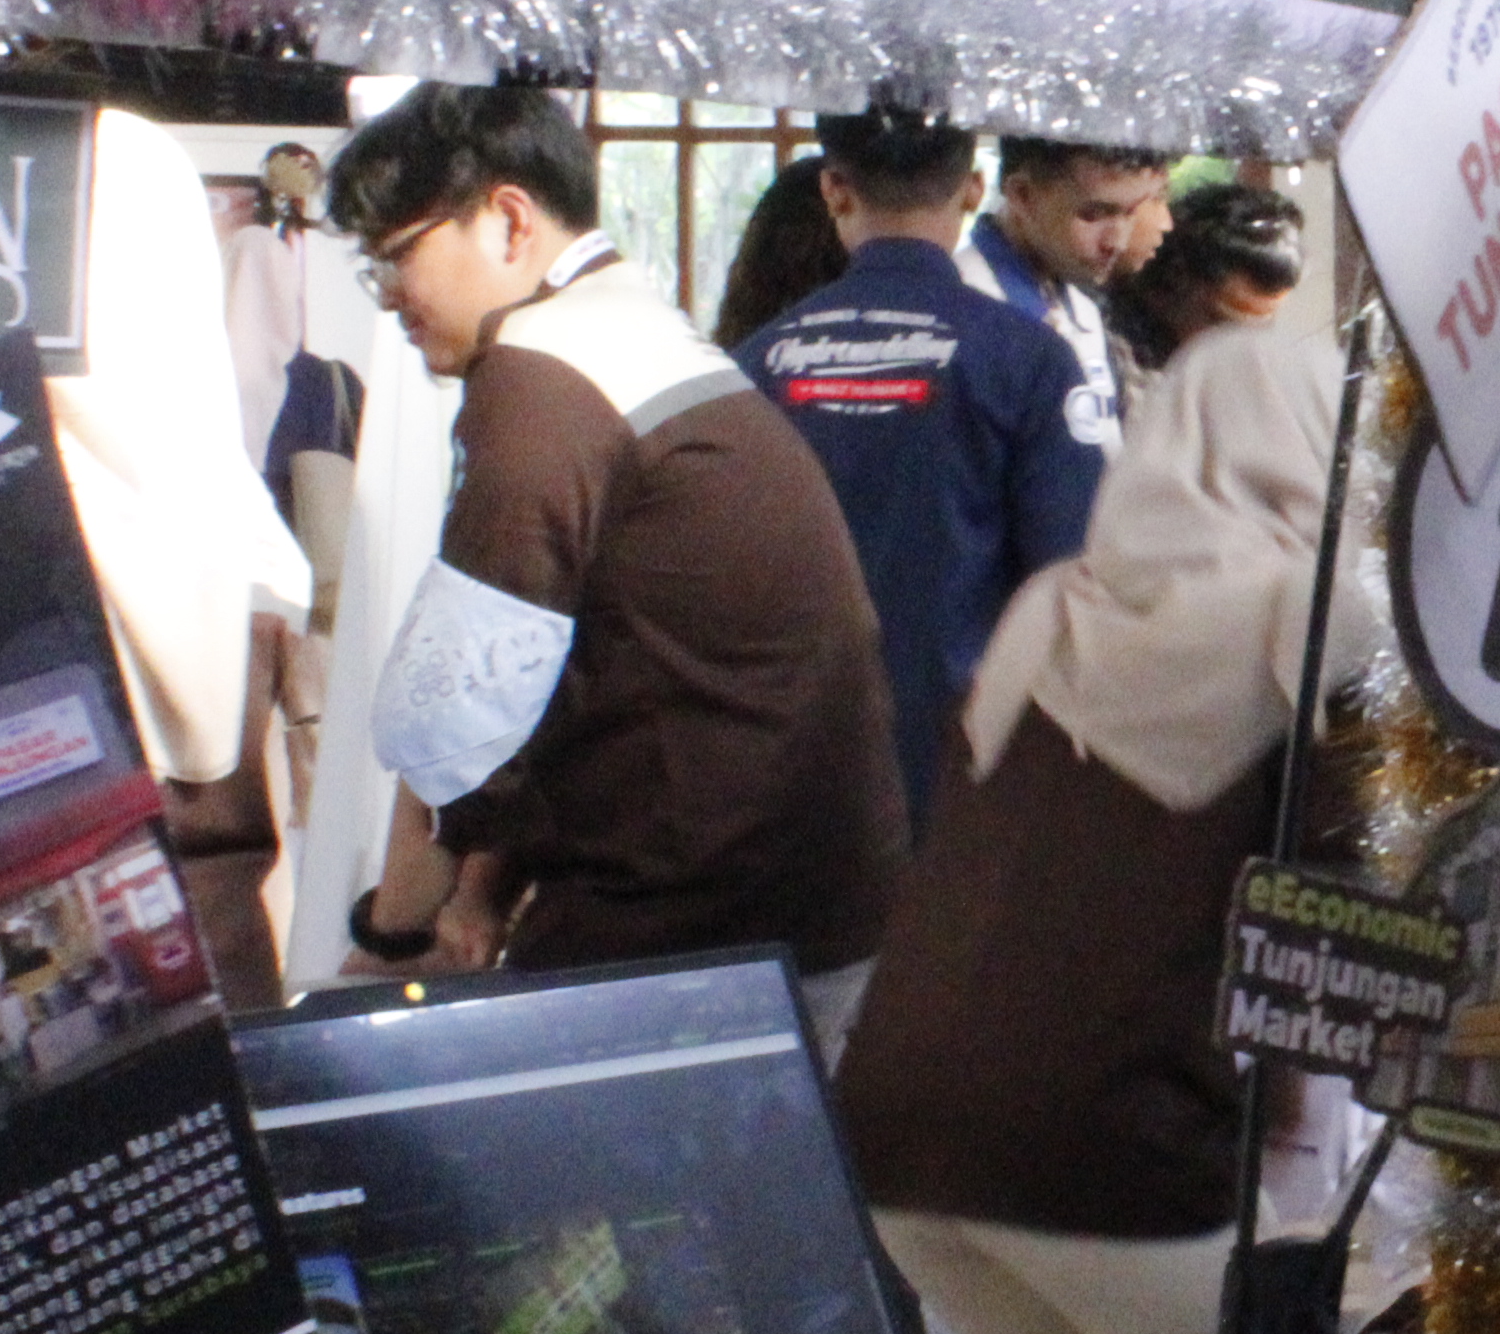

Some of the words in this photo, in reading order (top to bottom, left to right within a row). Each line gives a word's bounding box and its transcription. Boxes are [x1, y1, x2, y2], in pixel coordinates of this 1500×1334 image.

[1246, 874, 1461, 960] eEconomic
[1239, 924, 1447, 1020] Tunjungan
[1229, 988, 1376, 1066] Market
[80, 1128, 231, 1210] visualisasi
[126, 1101, 224, 1159] Market
[50, 1218, 104, 1256] dan
[111, 1152, 239, 1225] database
[150, 1176, 246, 1234] insight
[88, 1202, 253, 1297] penggunaan
[144, 1245, 225, 1296] usaha
[232, 1227, 261, 1251] di
